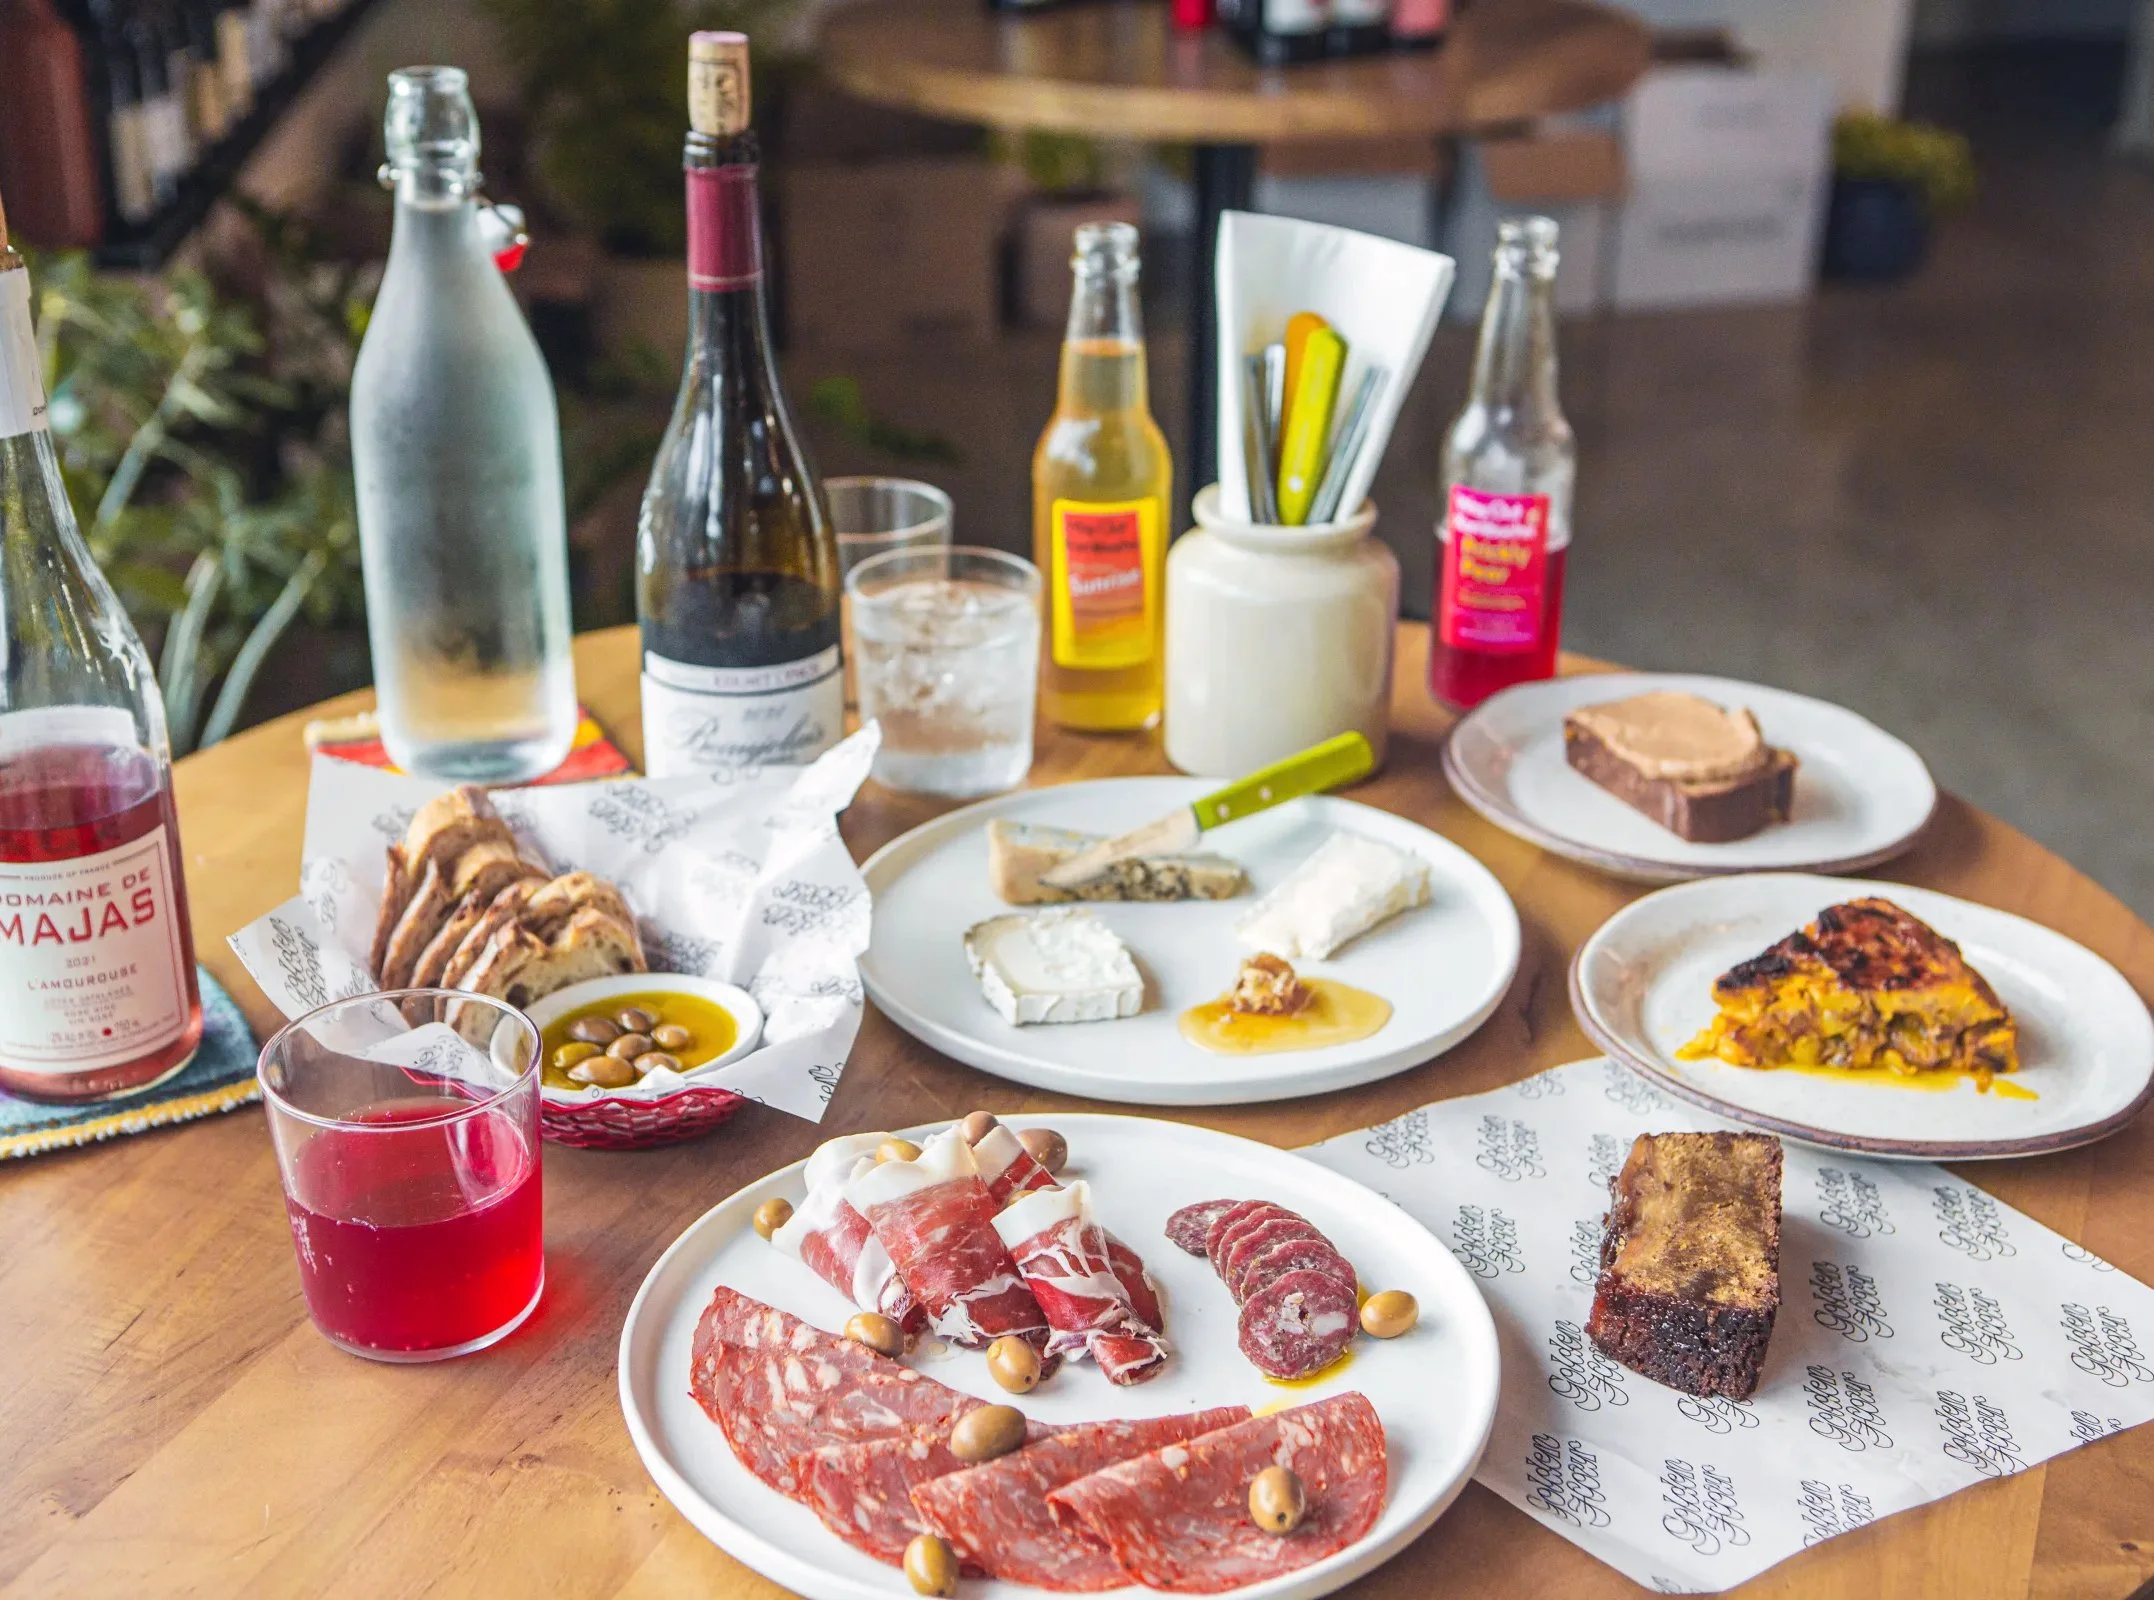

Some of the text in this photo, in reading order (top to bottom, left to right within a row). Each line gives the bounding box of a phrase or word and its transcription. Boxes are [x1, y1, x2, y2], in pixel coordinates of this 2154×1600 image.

[24, 861, 112, 882] PRODUCE OF FRANCE
[121, 866, 151, 890] DE
